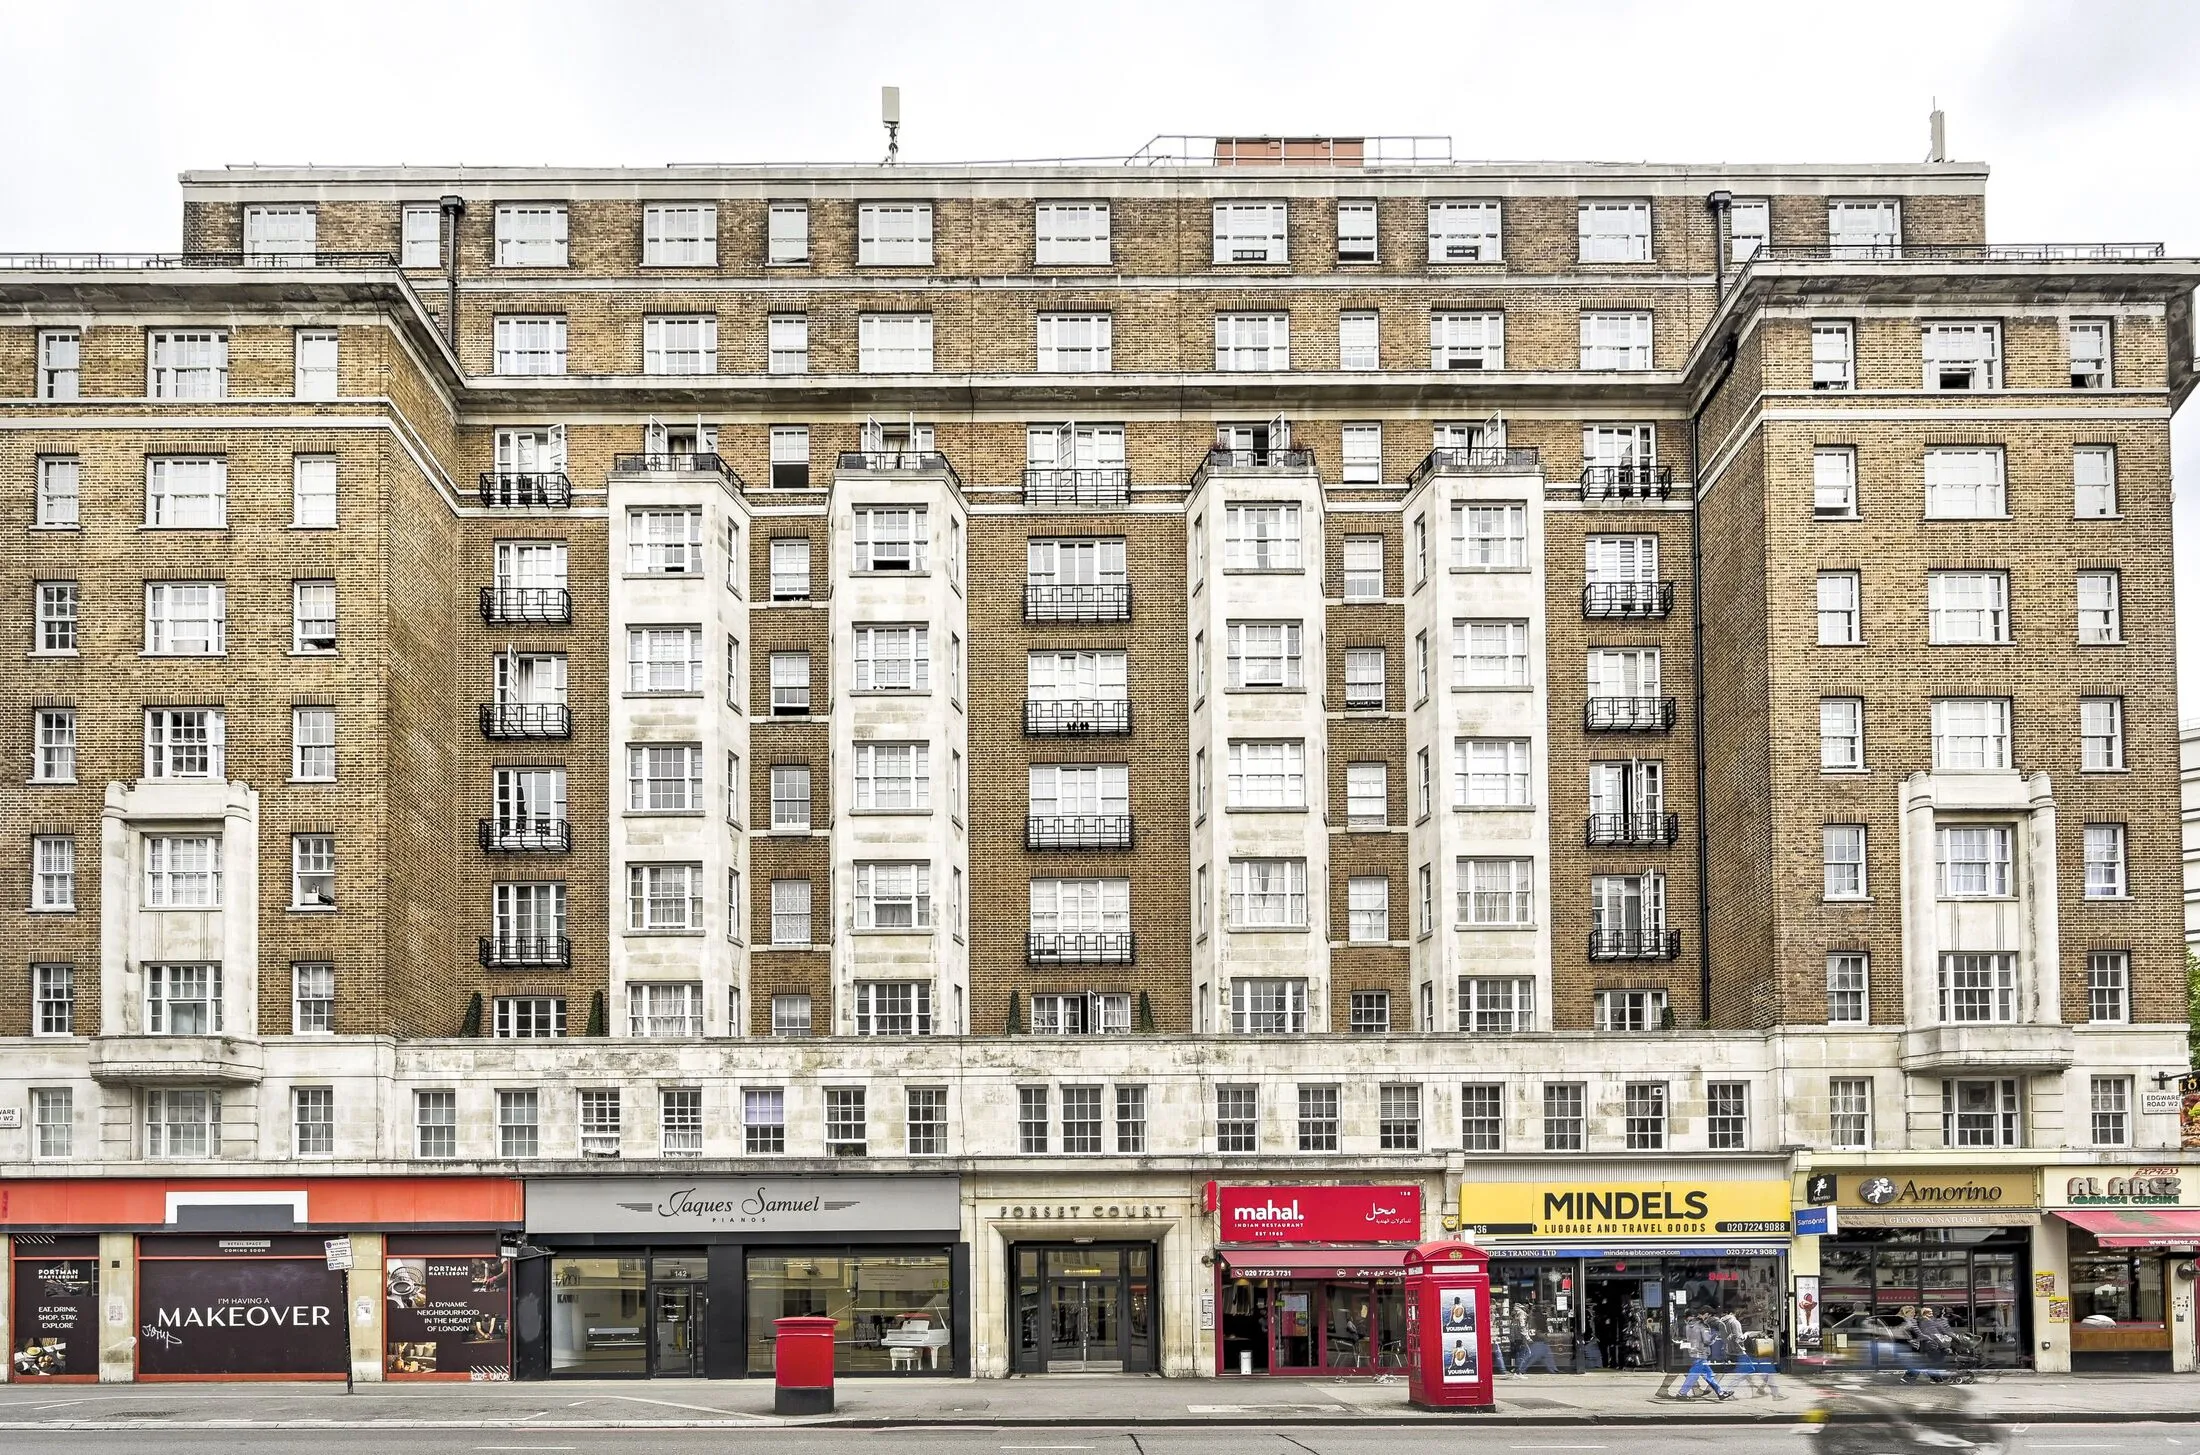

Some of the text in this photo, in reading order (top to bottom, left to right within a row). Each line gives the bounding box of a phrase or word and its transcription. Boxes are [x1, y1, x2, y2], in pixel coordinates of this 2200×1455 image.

[2134, 1167, 2179, 1176] EXPRESS
[1899, 1179, 2003, 1202] Amorino
[2067, 1177, 2182, 1196] AL AREZ
[658, 1186, 820, 1217] Jaques Samuel
[1234, 1199, 1305, 1221] mahal.
[1544, 1190, 1708, 1220] MINDELS
[1000, 1205, 1166, 1218] FORSET COURT
[1365, 1202, 1396, 1221] محل
[1473, 1225, 1487, 1234] 136
[1544, 1223, 1706, 1234] LUGGAGE AND TRAVEL GOODS
[157, 1306, 331, 1327] MAKEOVER
[1447, 1368, 1475, 1376] youswim
